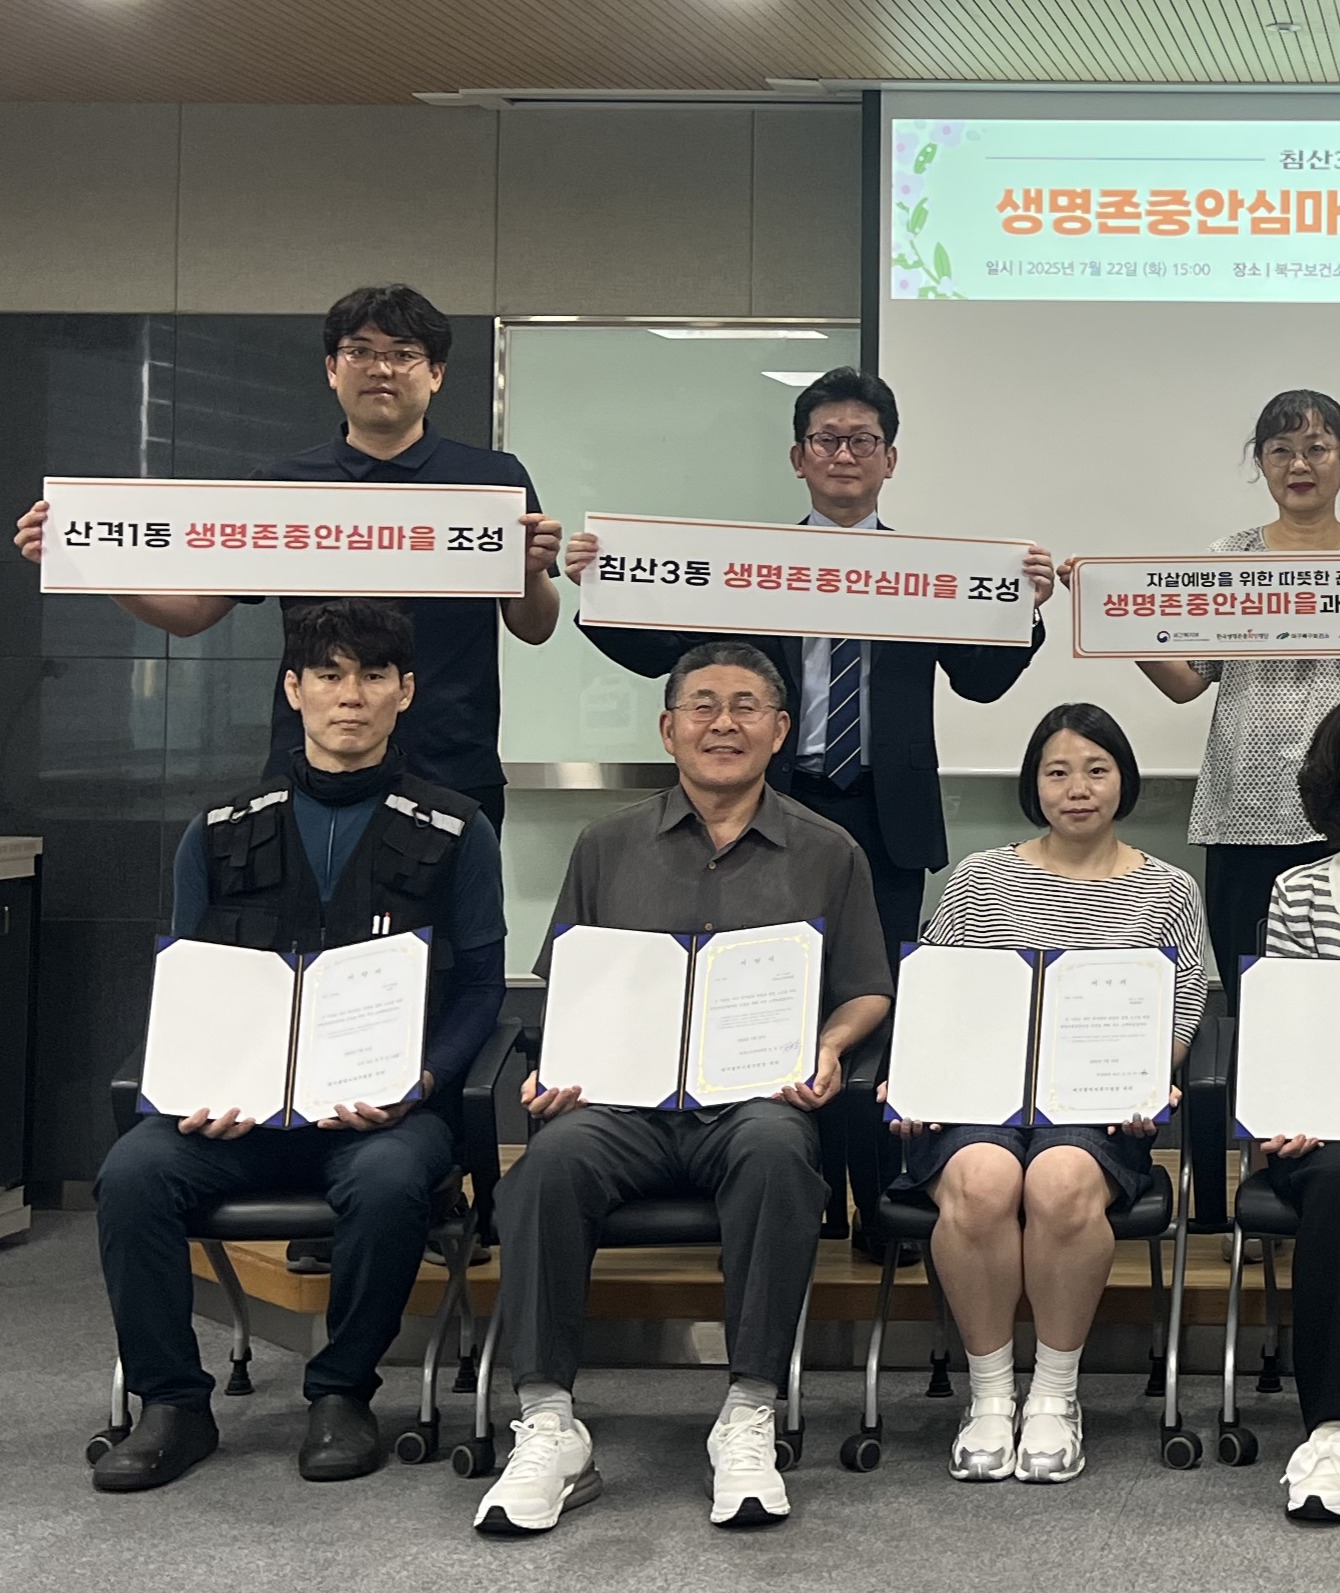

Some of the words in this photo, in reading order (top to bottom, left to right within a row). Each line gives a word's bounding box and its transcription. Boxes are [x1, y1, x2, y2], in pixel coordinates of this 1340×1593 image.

[986, 261, 1013, 276] 일시
[1027, 262, 1074, 276] 2025년
[1080, 262, 1101, 276] 7월
[1107, 262, 1137, 276] 22일
[1143, 261, 1167, 277] (화)
[1173, 263, 1211, 276] 15:00
[1233, 262, 1262, 278] 장소
[64, 521, 172, 548] 산격1동
[184, 523, 436, 551] 생명존중안심마을
[447, 526, 504, 552] 조성
[598, 555, 711, 587] 침산3동
[723, 563, 958, 600] 생명존중안심마을
[967, 575, 1021, 603] 조성
[1147, 571, 1233, 588] 자살예방을
[1239, 571, 1274, 587] 위한
[1279, 570, 1330, 587] 따뜻한
[1103, 591, 1340, 618] 생명존중안심마을과
